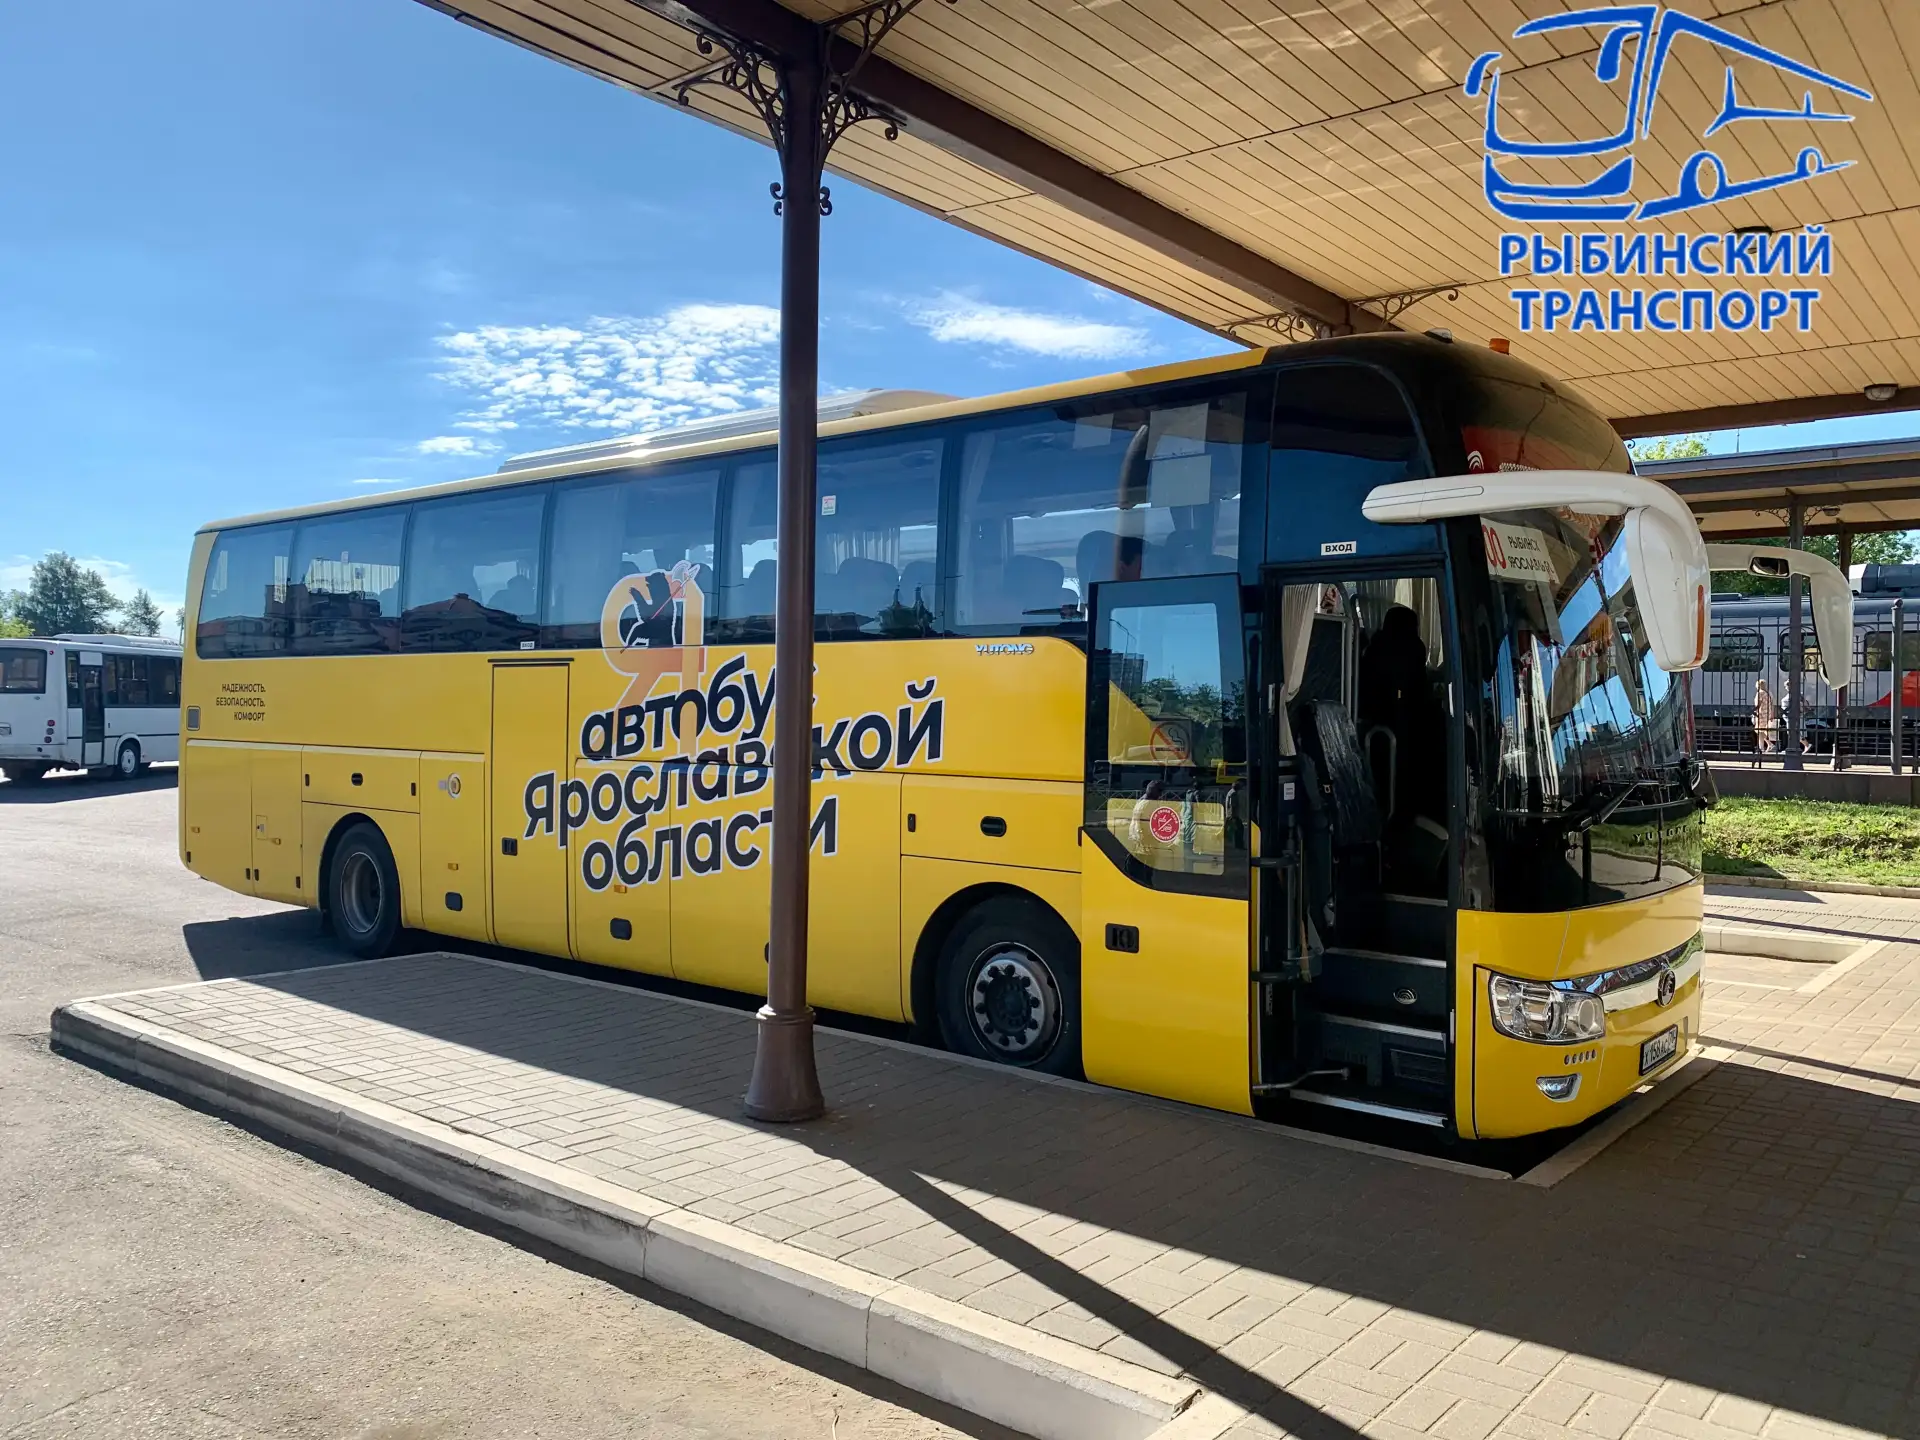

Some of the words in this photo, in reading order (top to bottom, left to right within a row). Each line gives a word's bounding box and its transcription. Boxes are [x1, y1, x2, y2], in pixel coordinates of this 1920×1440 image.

[1325, 543, 1353, 553] ВХОД
[1507, 535, 1541, 552] РЫБИНСК
[233, 711, 265, 721] КОМФОРТ
[580, 653, 817, 762] автобу
[523, 676, 945, 848] Ярославкой
[581, 797, 838, 892] обласи
